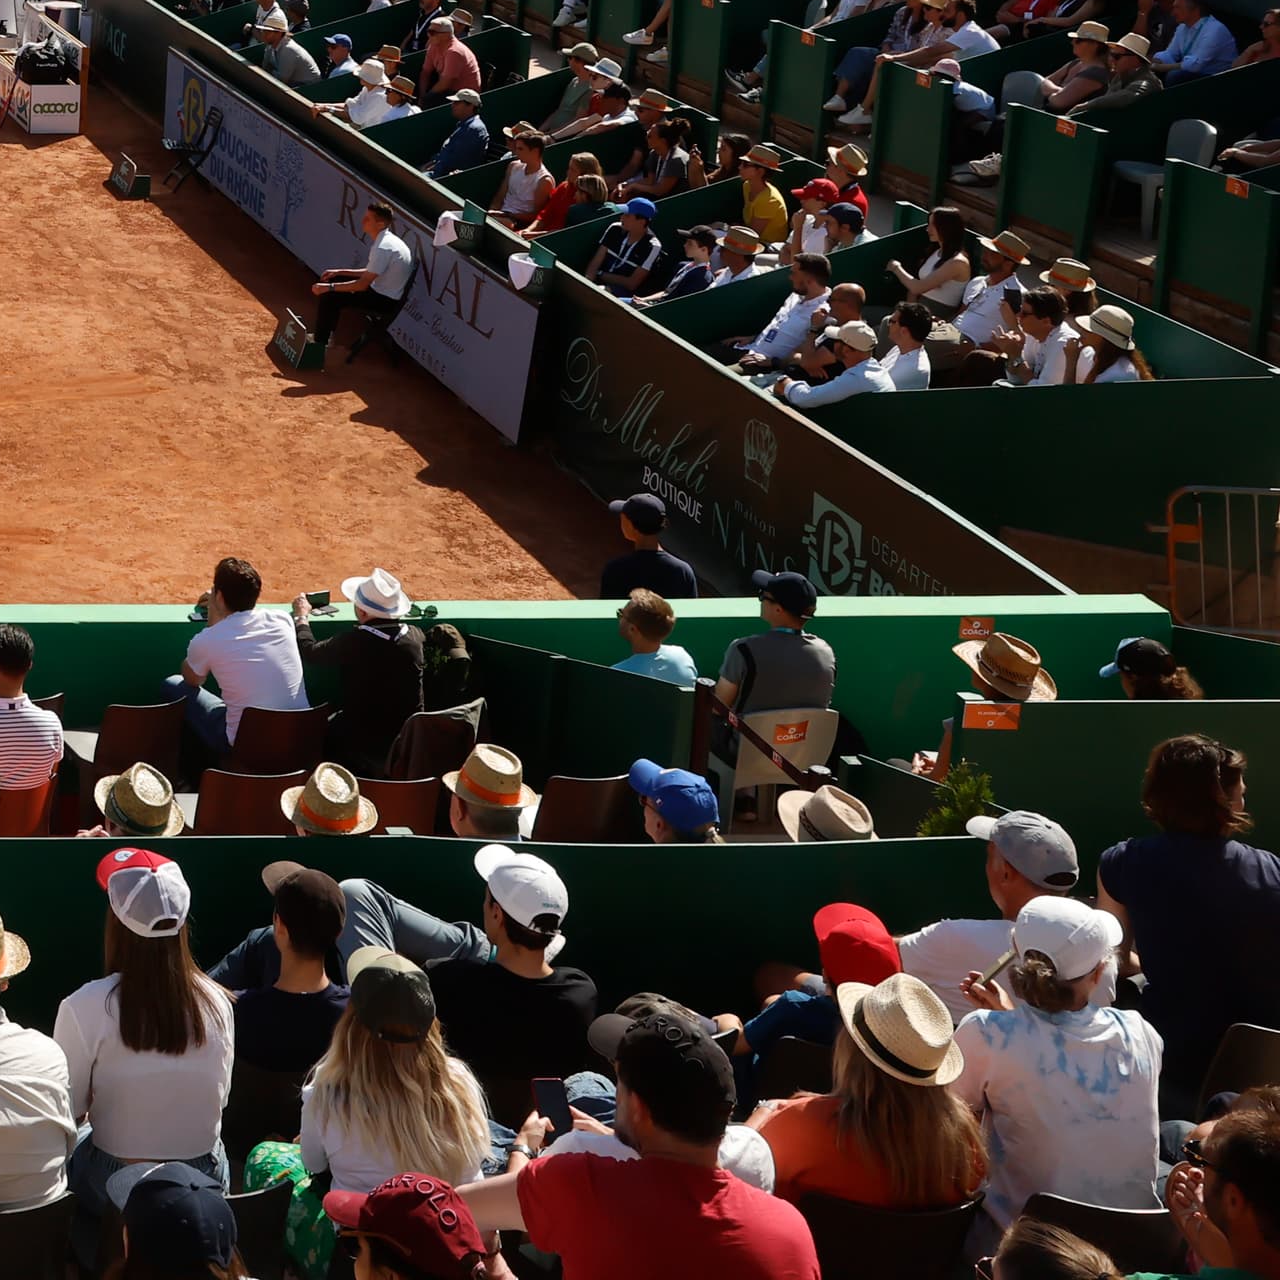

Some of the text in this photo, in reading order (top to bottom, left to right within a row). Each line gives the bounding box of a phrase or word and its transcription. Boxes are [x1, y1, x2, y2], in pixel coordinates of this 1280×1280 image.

[33, 101, 79, 115] accord
[209, 151, 267, 219] DU RHÔNE
[560, 335, 721, 496] Di Micheli
[642, 465, 704, 524] BOUTIQUE
[734, 498, 777, 539] maison
[962, 628, 990, 636] COACH
[776, 732, 805, 742] COACH
